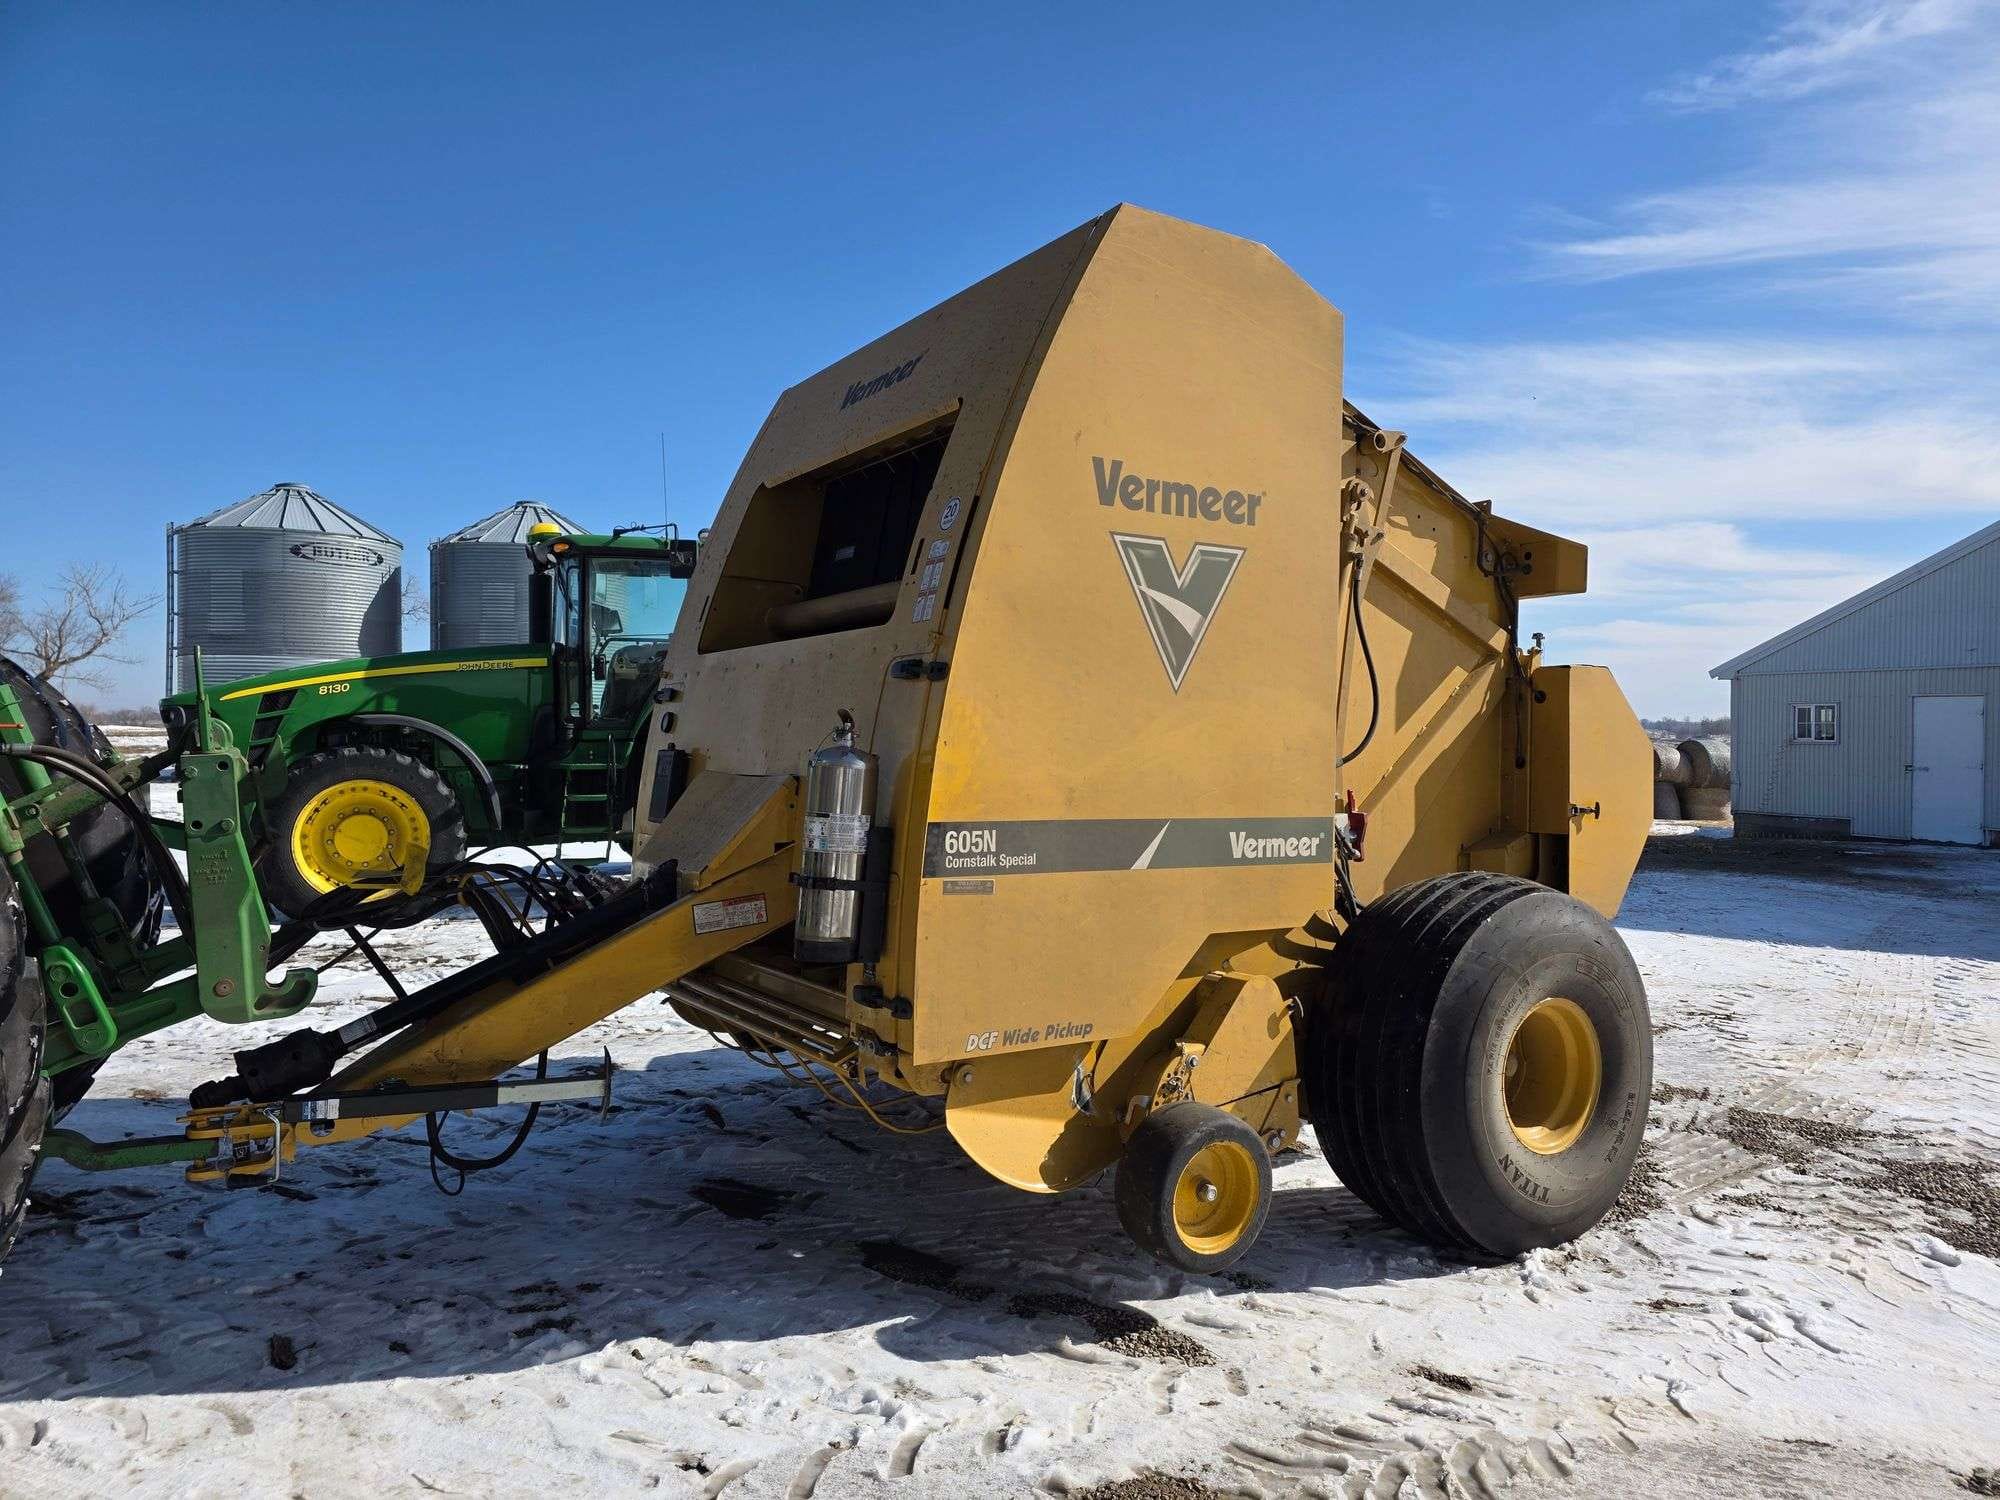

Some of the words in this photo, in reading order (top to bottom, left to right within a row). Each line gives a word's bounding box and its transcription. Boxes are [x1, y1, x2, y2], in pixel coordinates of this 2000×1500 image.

[840, 354, 923, 411] Vermeer
[1092, 456, 1262, 526] Vermeer
[456, 663, 482, 671] JOHN
[482, 661, 514, 669] DEERE
[318, 683, 350, 695] 8130
[945, 830, 997, 854] 605N
[1229, 831, 1320, 859] Vermeer
[945, 855, 997, 868] Cornstalk
[999, 853, 1037, 868] Special
[965, 1031, 999, 1053] DCF
[1002, 1027, 1040, 1047] Wide
[1044, 1021, 1093, 1041] Pickup
[1498, 1154, 1551, 1203] TITAN
